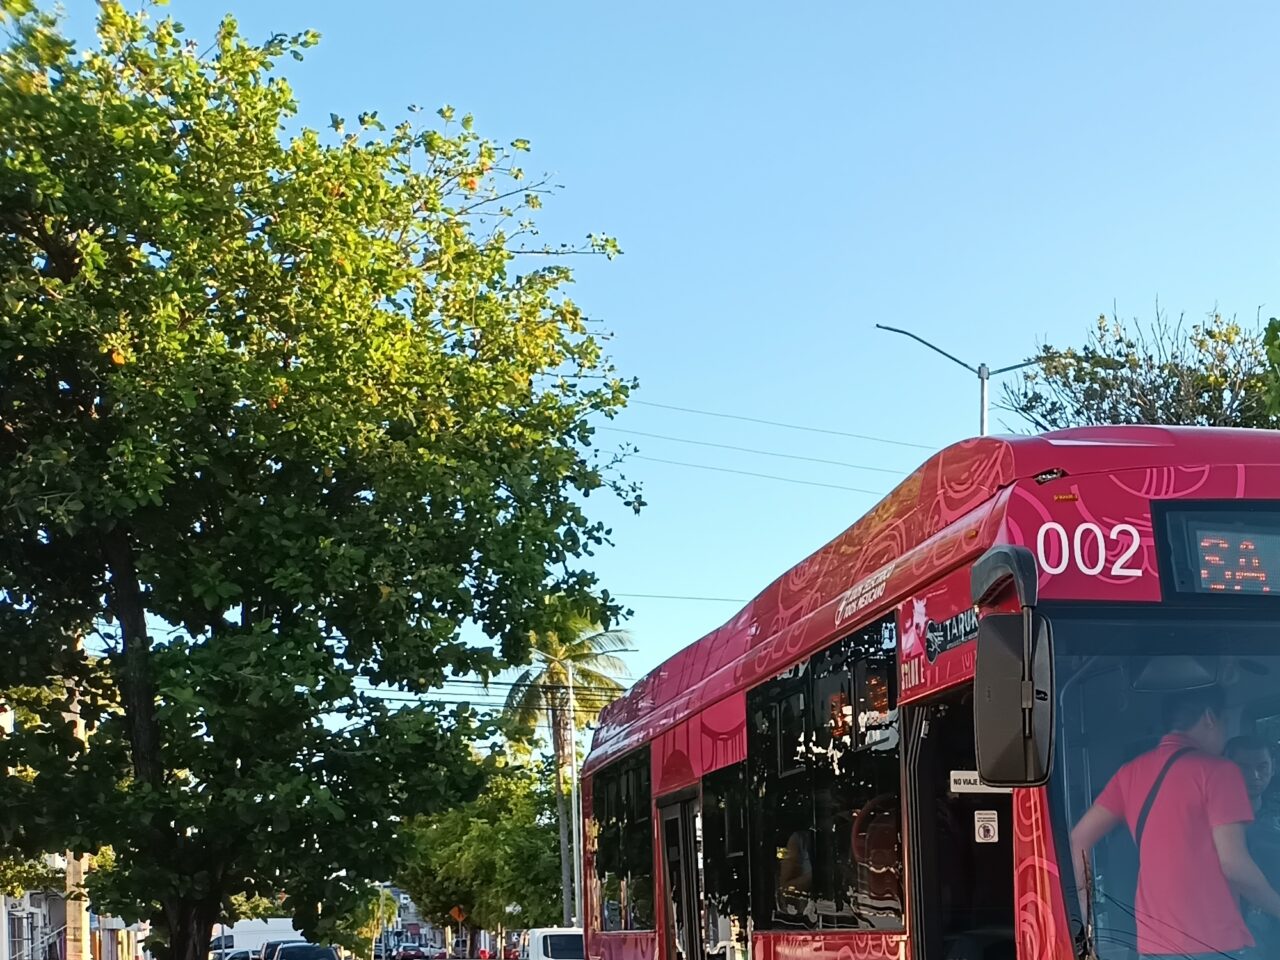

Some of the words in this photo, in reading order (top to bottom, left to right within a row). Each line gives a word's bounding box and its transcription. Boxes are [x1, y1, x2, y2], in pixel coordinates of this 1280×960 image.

[1037, 521, 1143, 577] 002
[953, 778, 962, 786] NO
[962, 778, 978, 786] VIAJE
